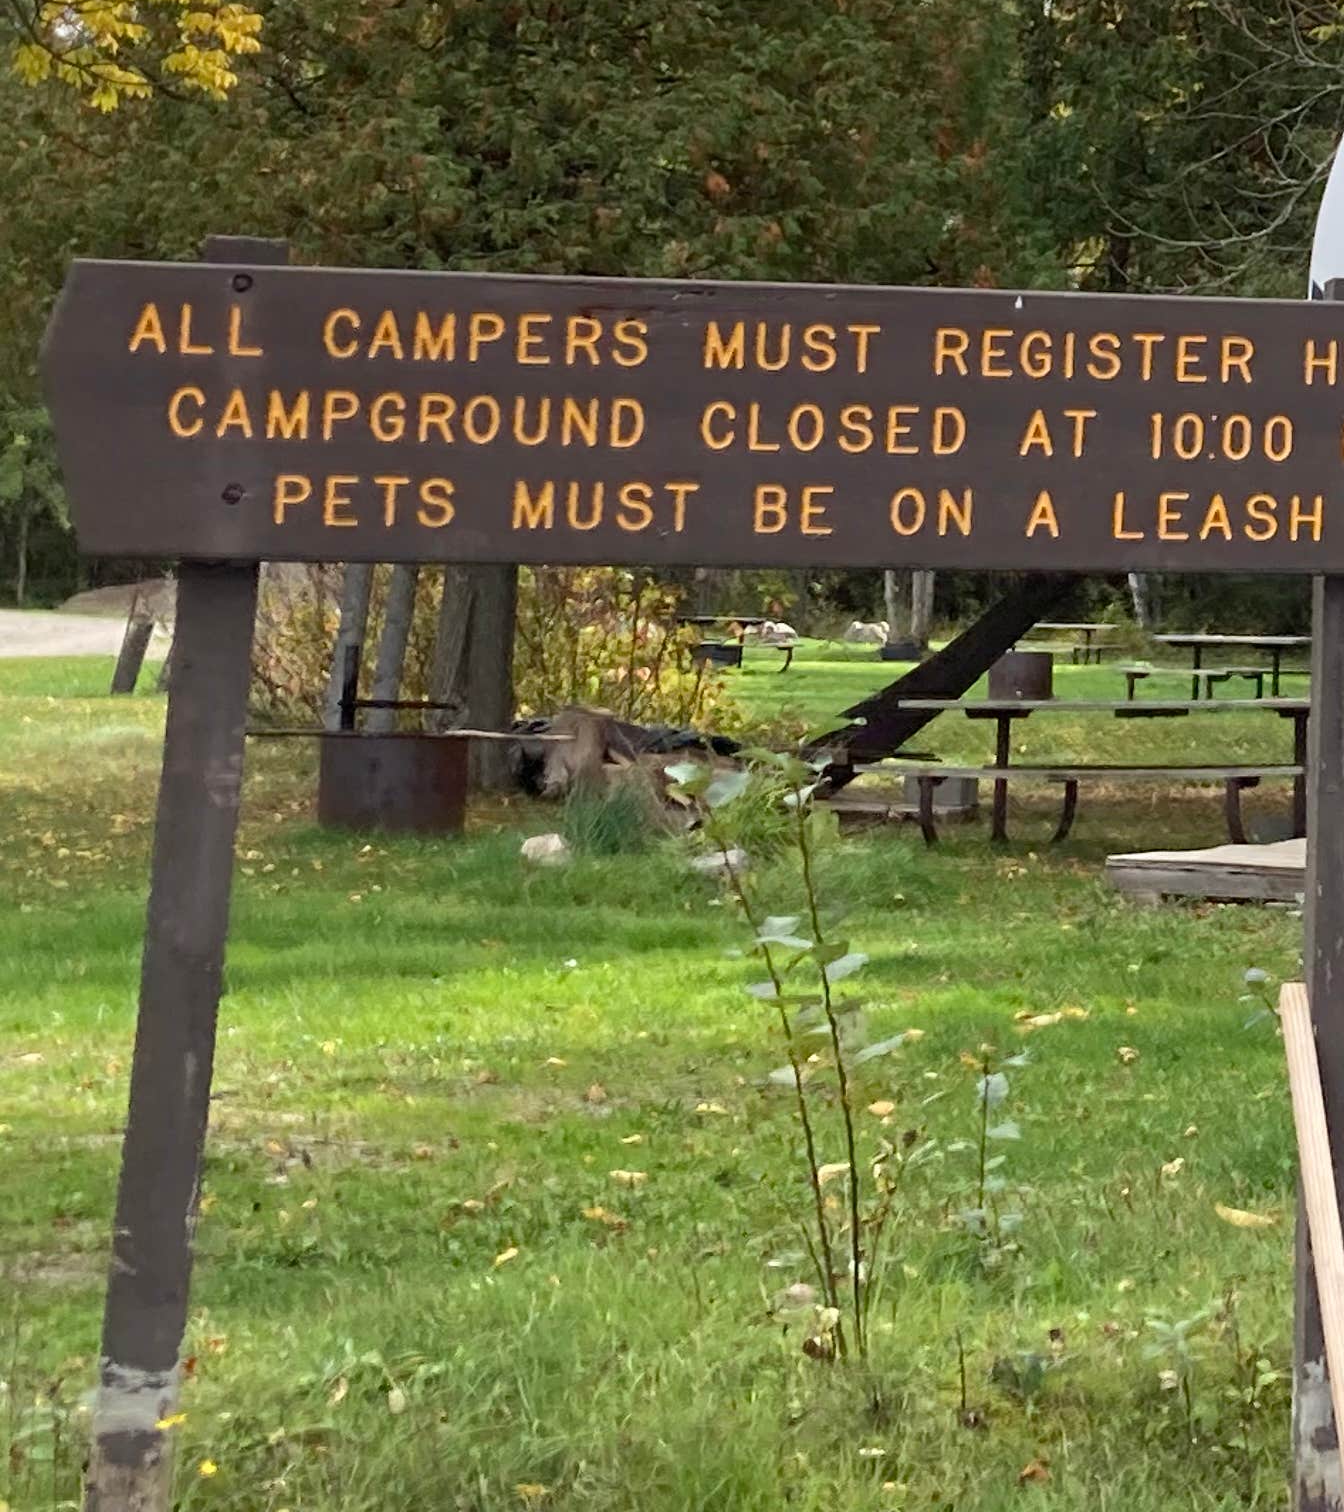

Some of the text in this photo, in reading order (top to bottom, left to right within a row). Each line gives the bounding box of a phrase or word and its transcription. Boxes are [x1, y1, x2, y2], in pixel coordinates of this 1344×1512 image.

[128, 301, 263, 357] ALL
[323, 307, 650, 367] CAMPERS
[703, 320, 880, 371] MUST
[934, 328, 1255, 385] REGISTER
[168, 387, 647, 449] CAMPGROUND
[701, 401, 967, 456] CLOSED
[1019, 408, 1097, 458] AT
[272, 475, 1324, 542] PETS MUST BE ON A LEASH
